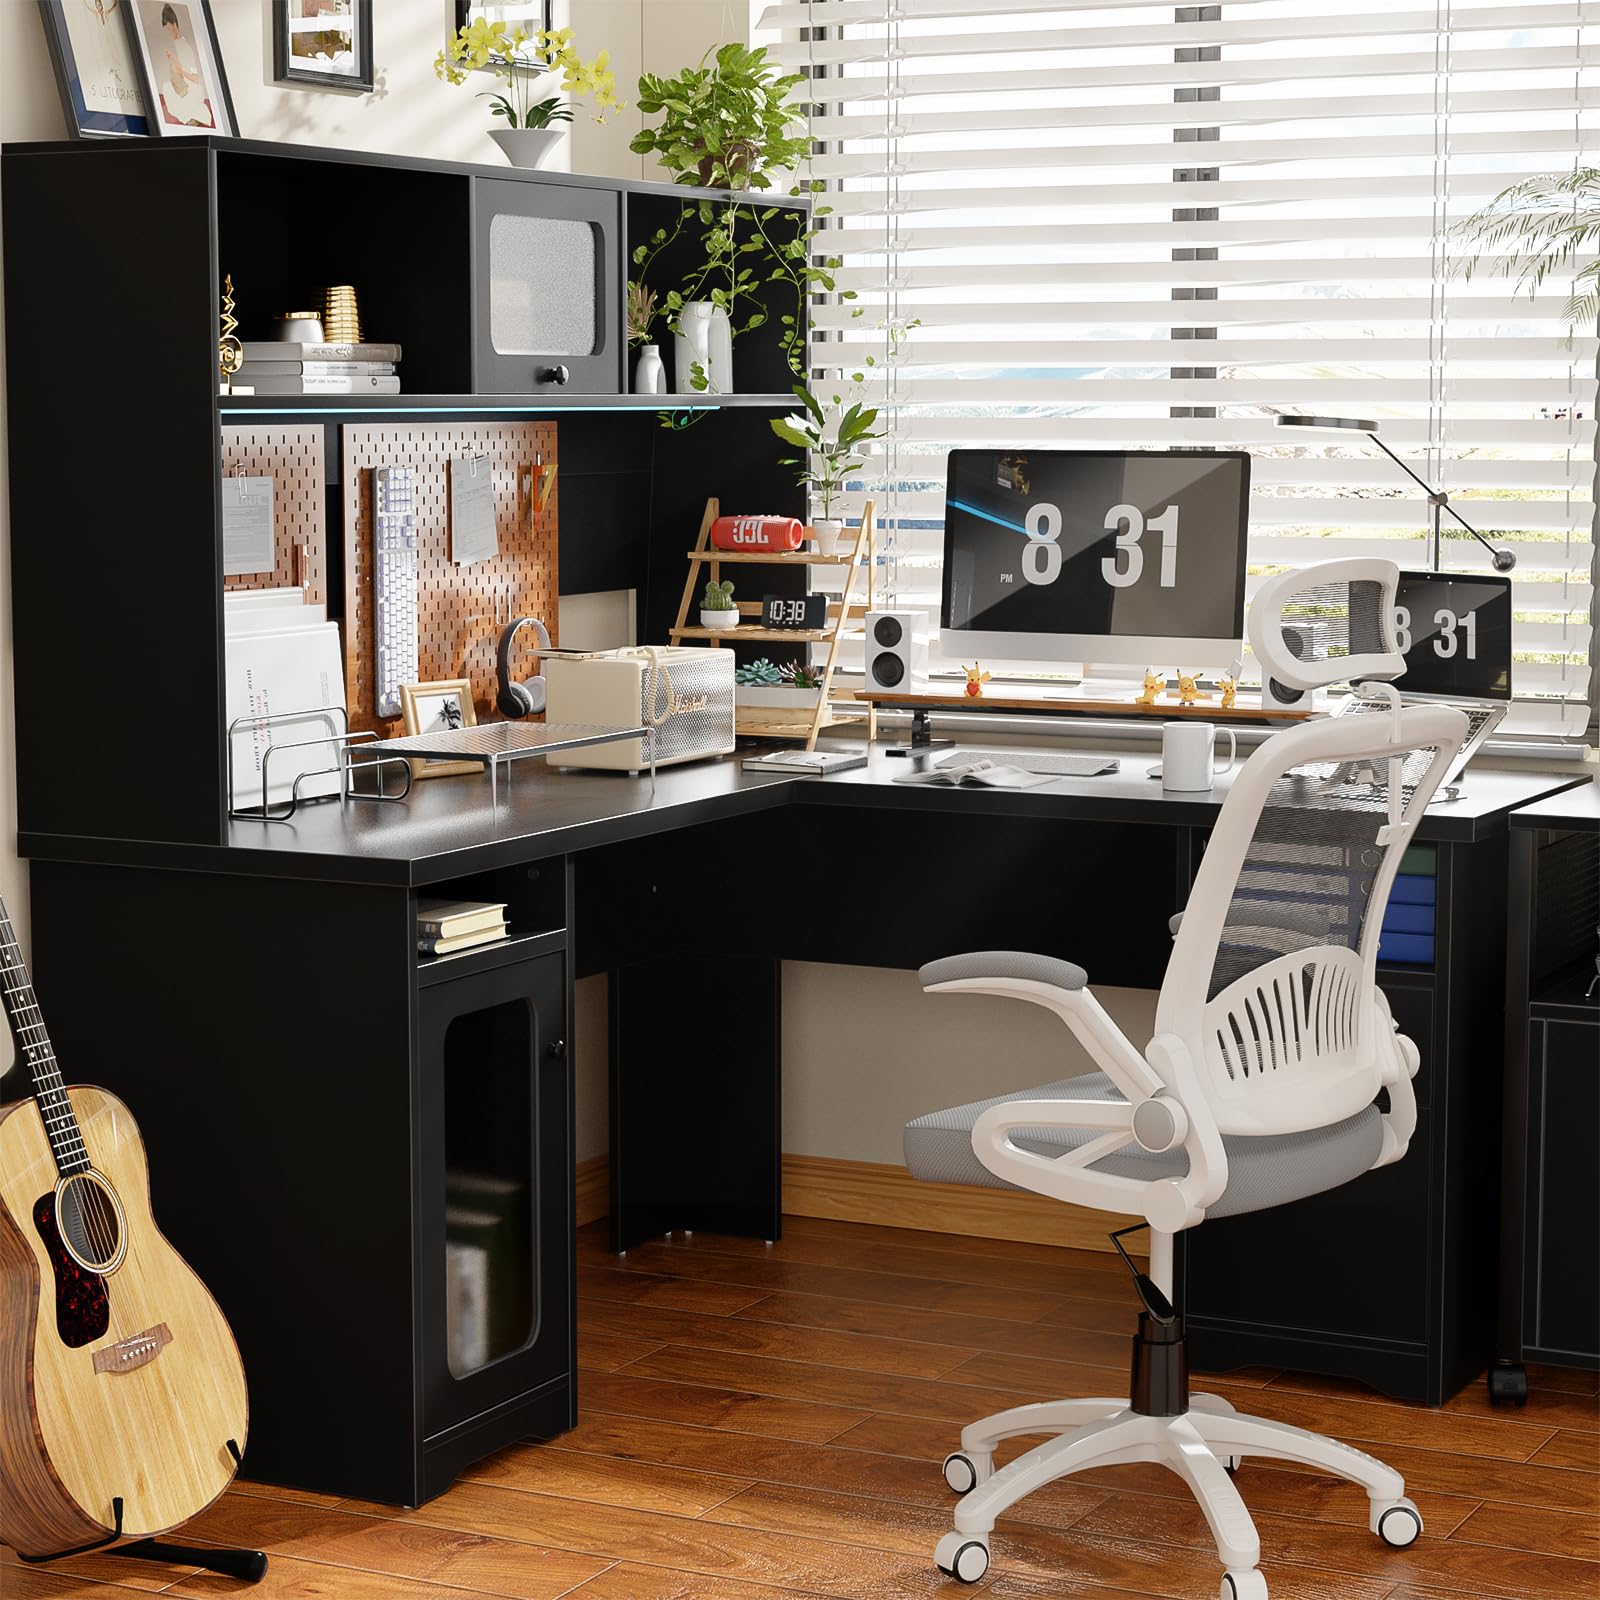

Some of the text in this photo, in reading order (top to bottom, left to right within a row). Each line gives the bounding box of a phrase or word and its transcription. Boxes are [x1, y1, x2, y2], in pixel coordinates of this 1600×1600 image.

[732, 520, 769, 544] JBL
[1021, 503, 1179, 588] 8 31
[1000, 573, 1013, 584] PM
[769, 600, 806, 621] 10:38
[1393, 606, 1476, 660] 8 31
